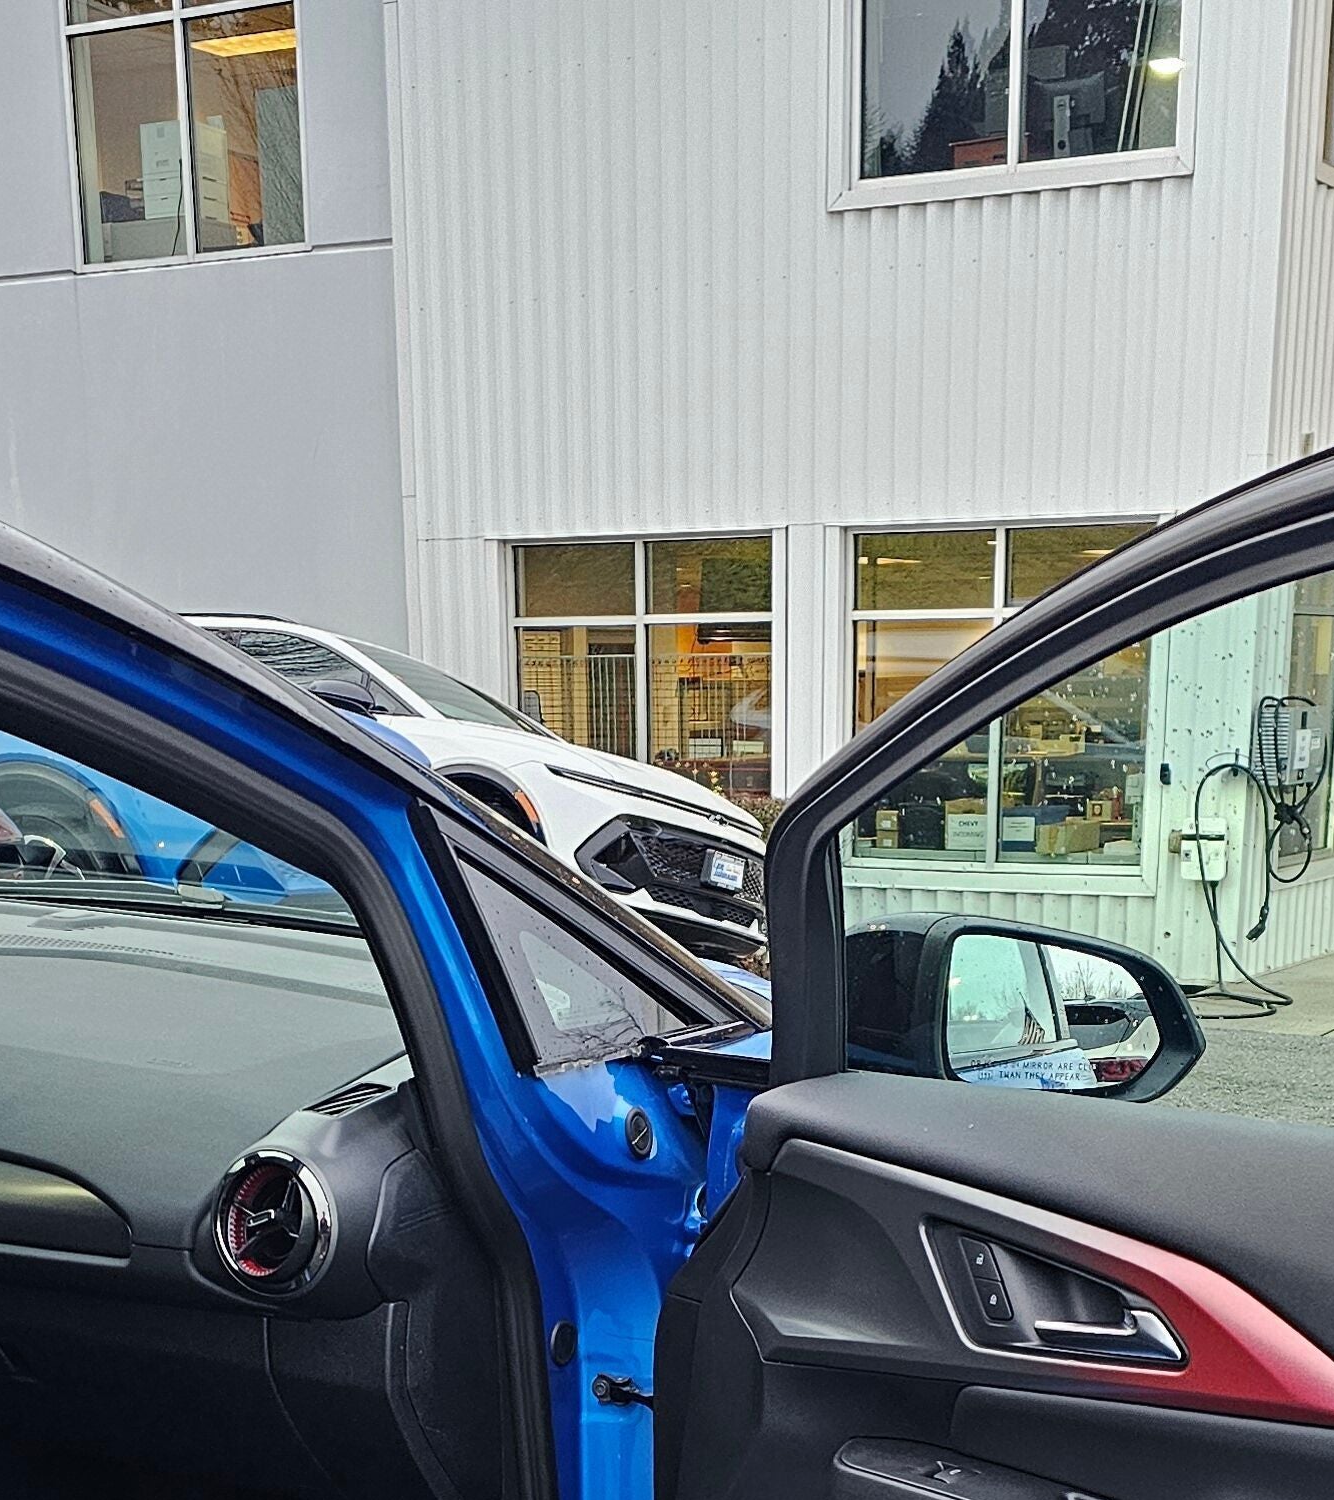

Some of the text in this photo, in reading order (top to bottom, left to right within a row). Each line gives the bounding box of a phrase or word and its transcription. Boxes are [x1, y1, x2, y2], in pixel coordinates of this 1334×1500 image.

[1023, 1062, 1053, 1070] MIRROR
[999, 1071, 1021, 1079] THAN
[1049, 1073, 1080, 1081] APPEAR
